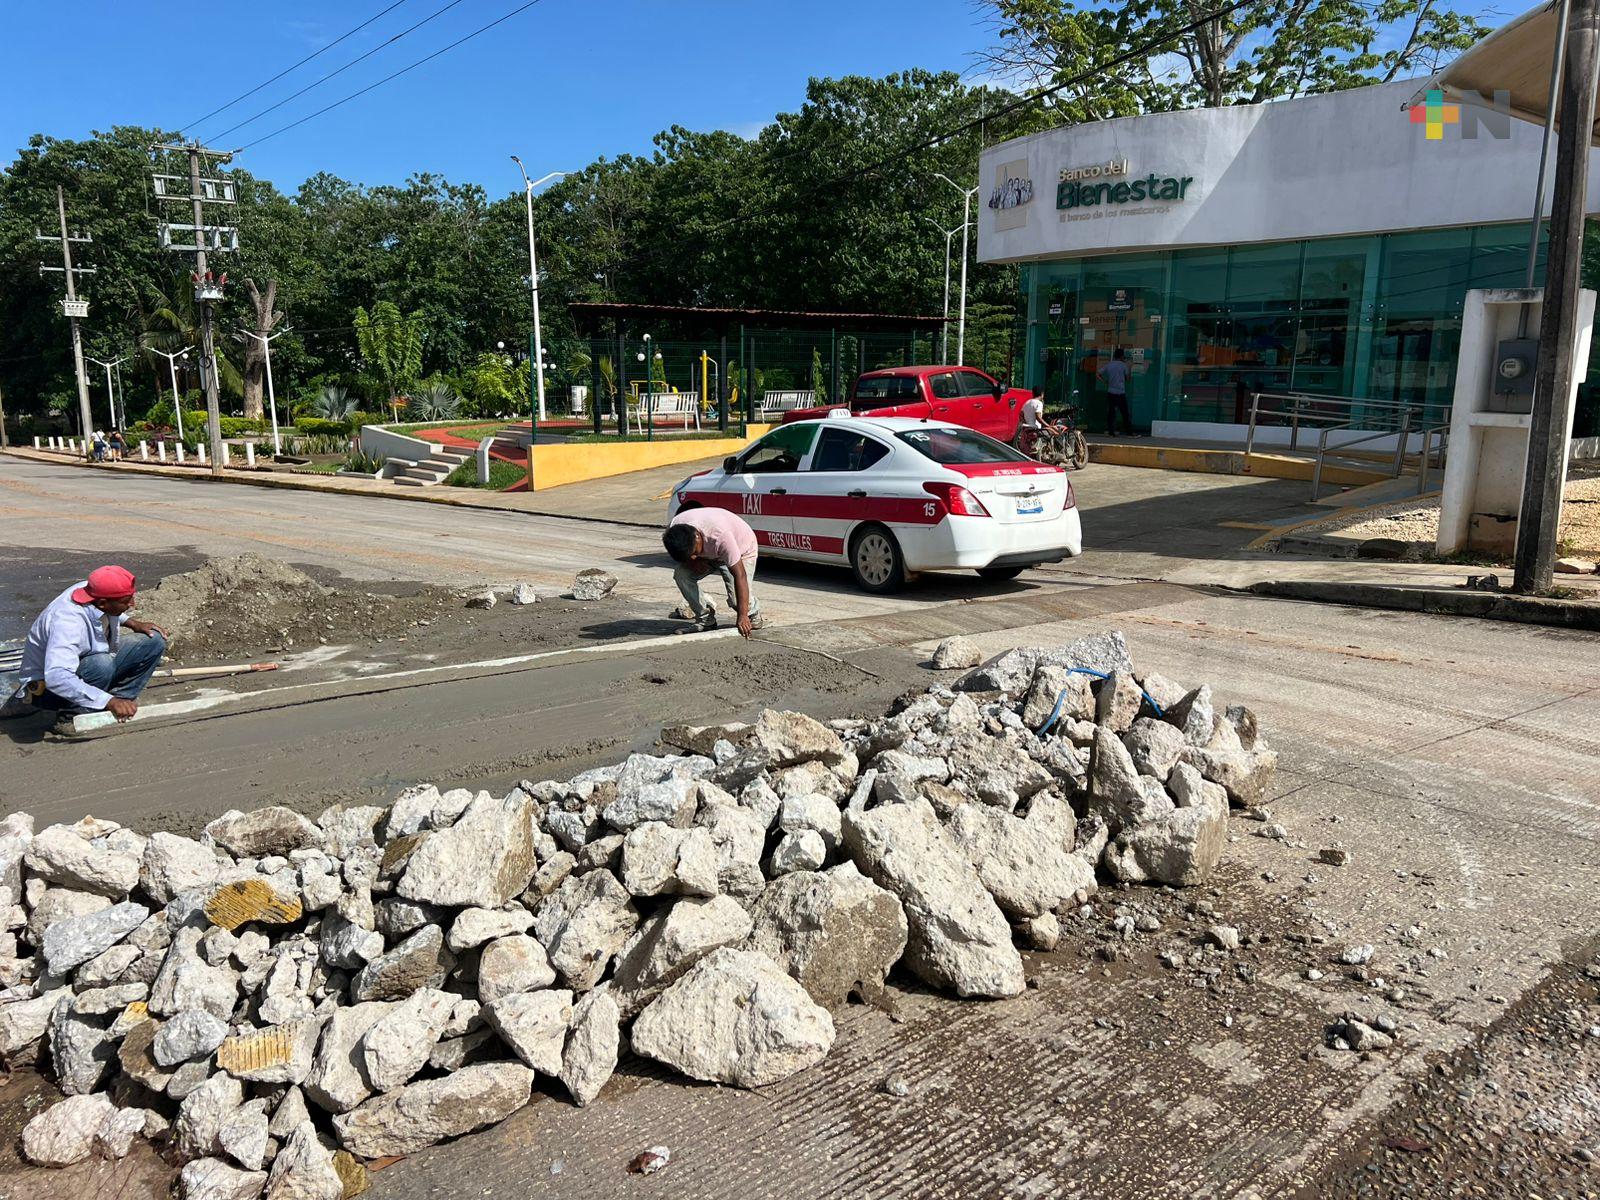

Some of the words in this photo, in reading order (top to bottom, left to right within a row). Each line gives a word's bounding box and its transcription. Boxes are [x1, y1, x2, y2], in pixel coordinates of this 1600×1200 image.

[1058, 166, 1101, 182] Banco
[1104, 158, 1128, 176] del
[1056, 173, 1194, 210] Bienestar
[1067, 212, 1091, 222] banco
[1093, 209, 1103, 219] de
[1105, 208, 1117, 218] los
[910, 431, 931, 442] 15
[741, 493, 762, 514] TAXI
[923, 502, 936, 517] 15
[767, 532, 786, 548] TRES
[785, 534, 813, 551] VALLES
